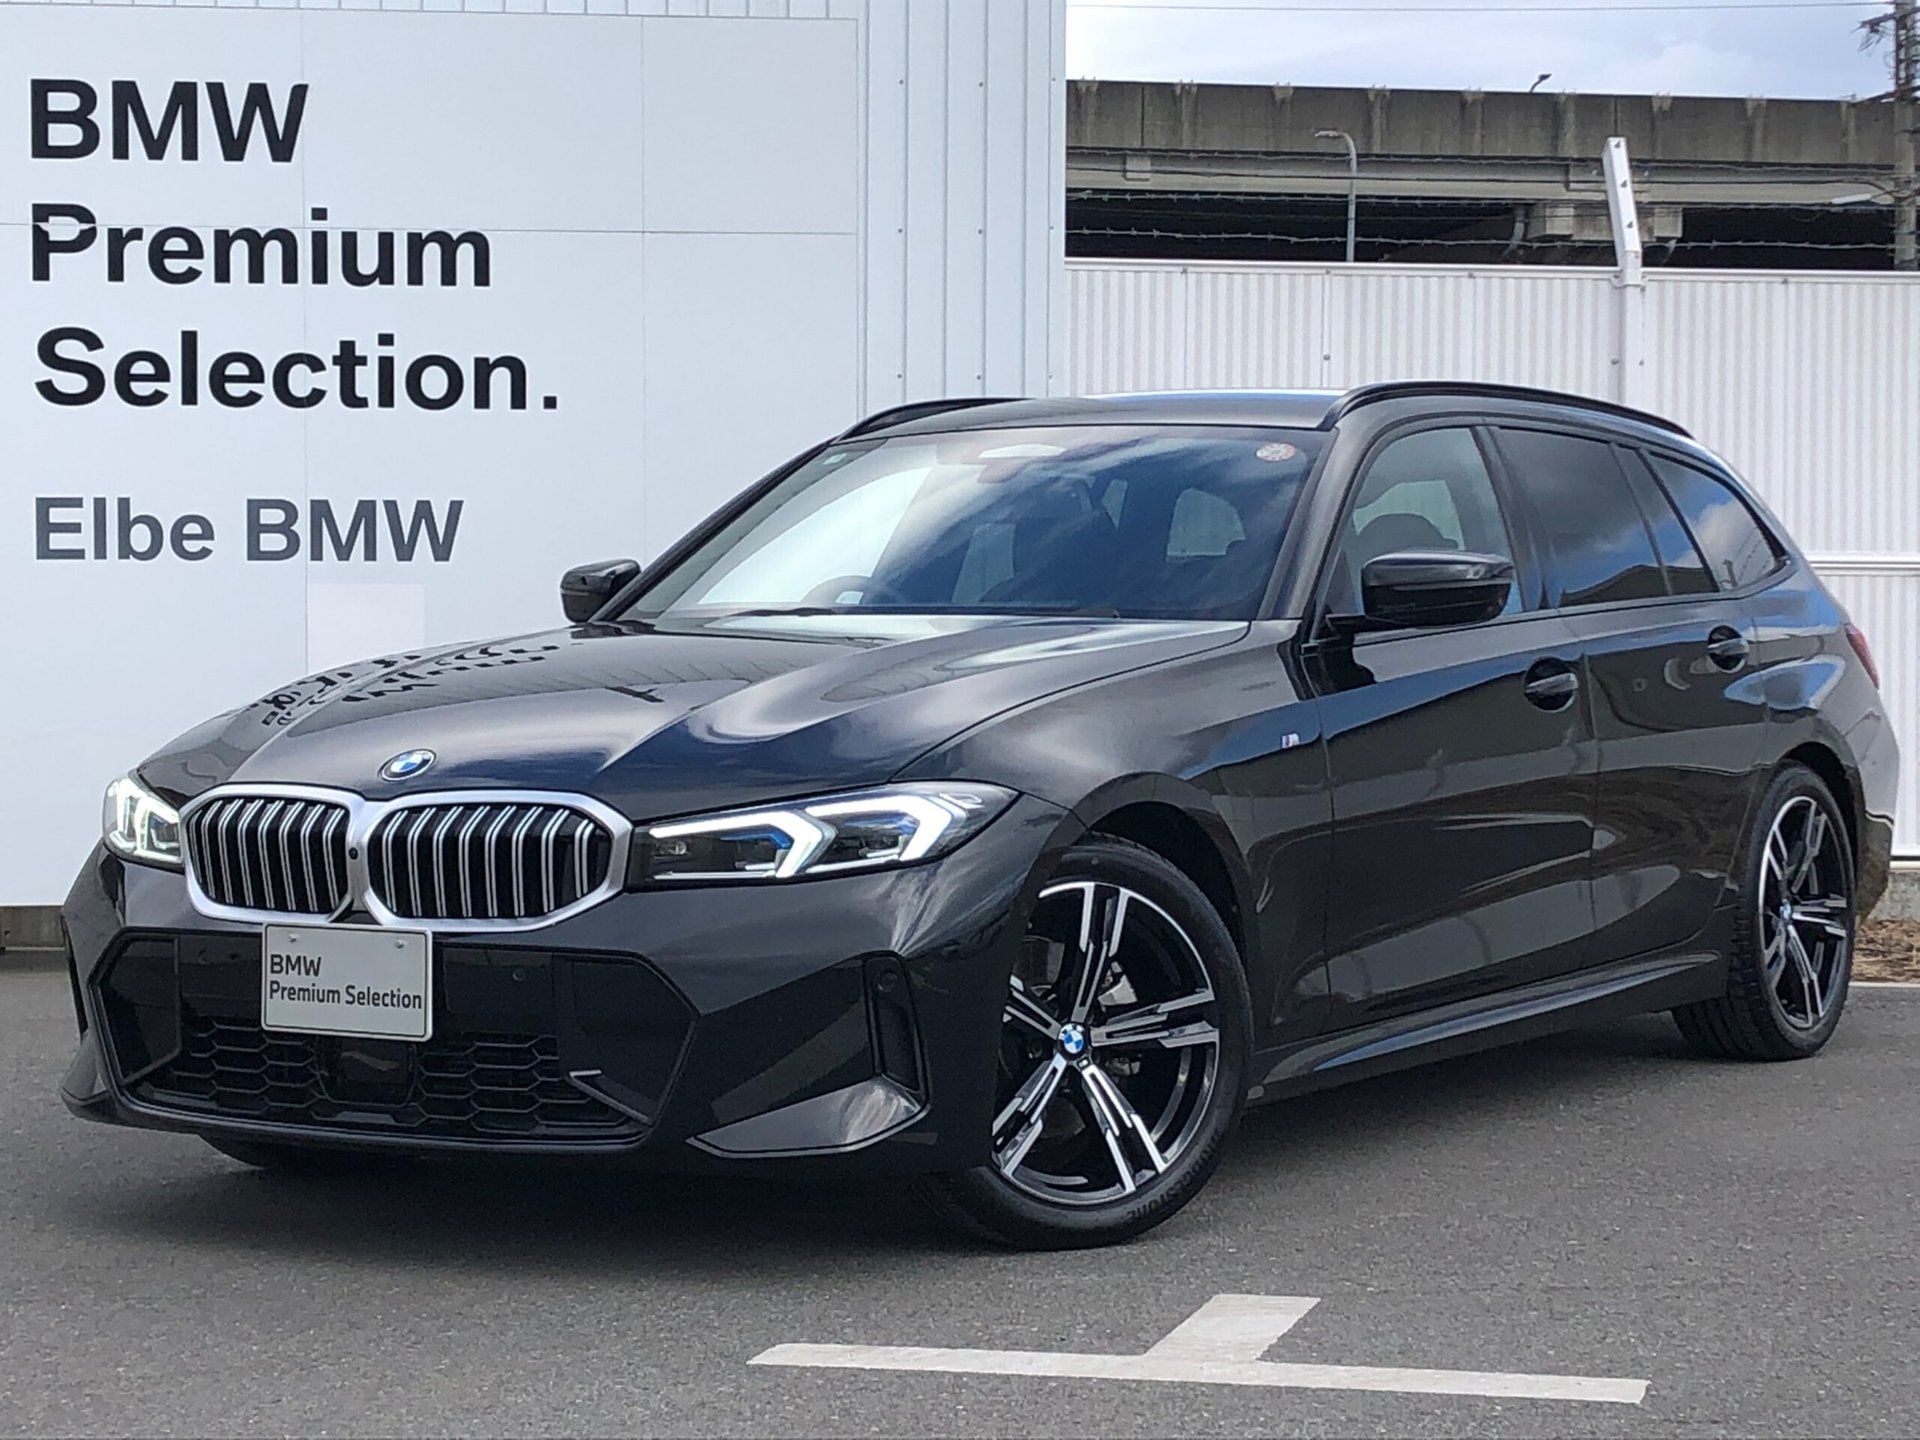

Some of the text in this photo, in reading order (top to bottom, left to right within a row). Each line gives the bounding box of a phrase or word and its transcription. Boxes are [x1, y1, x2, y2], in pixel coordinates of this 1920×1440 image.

[29, 77, 310, 164] BMW
[31, 202, 491, 288] Premium
[34, 326, 558, 411] Selection.
[35, 496, 465, 563] Elbe BMW
[269, 953, 323, 978] BMW
[269, 979, 423, 1010] Premium Selection
